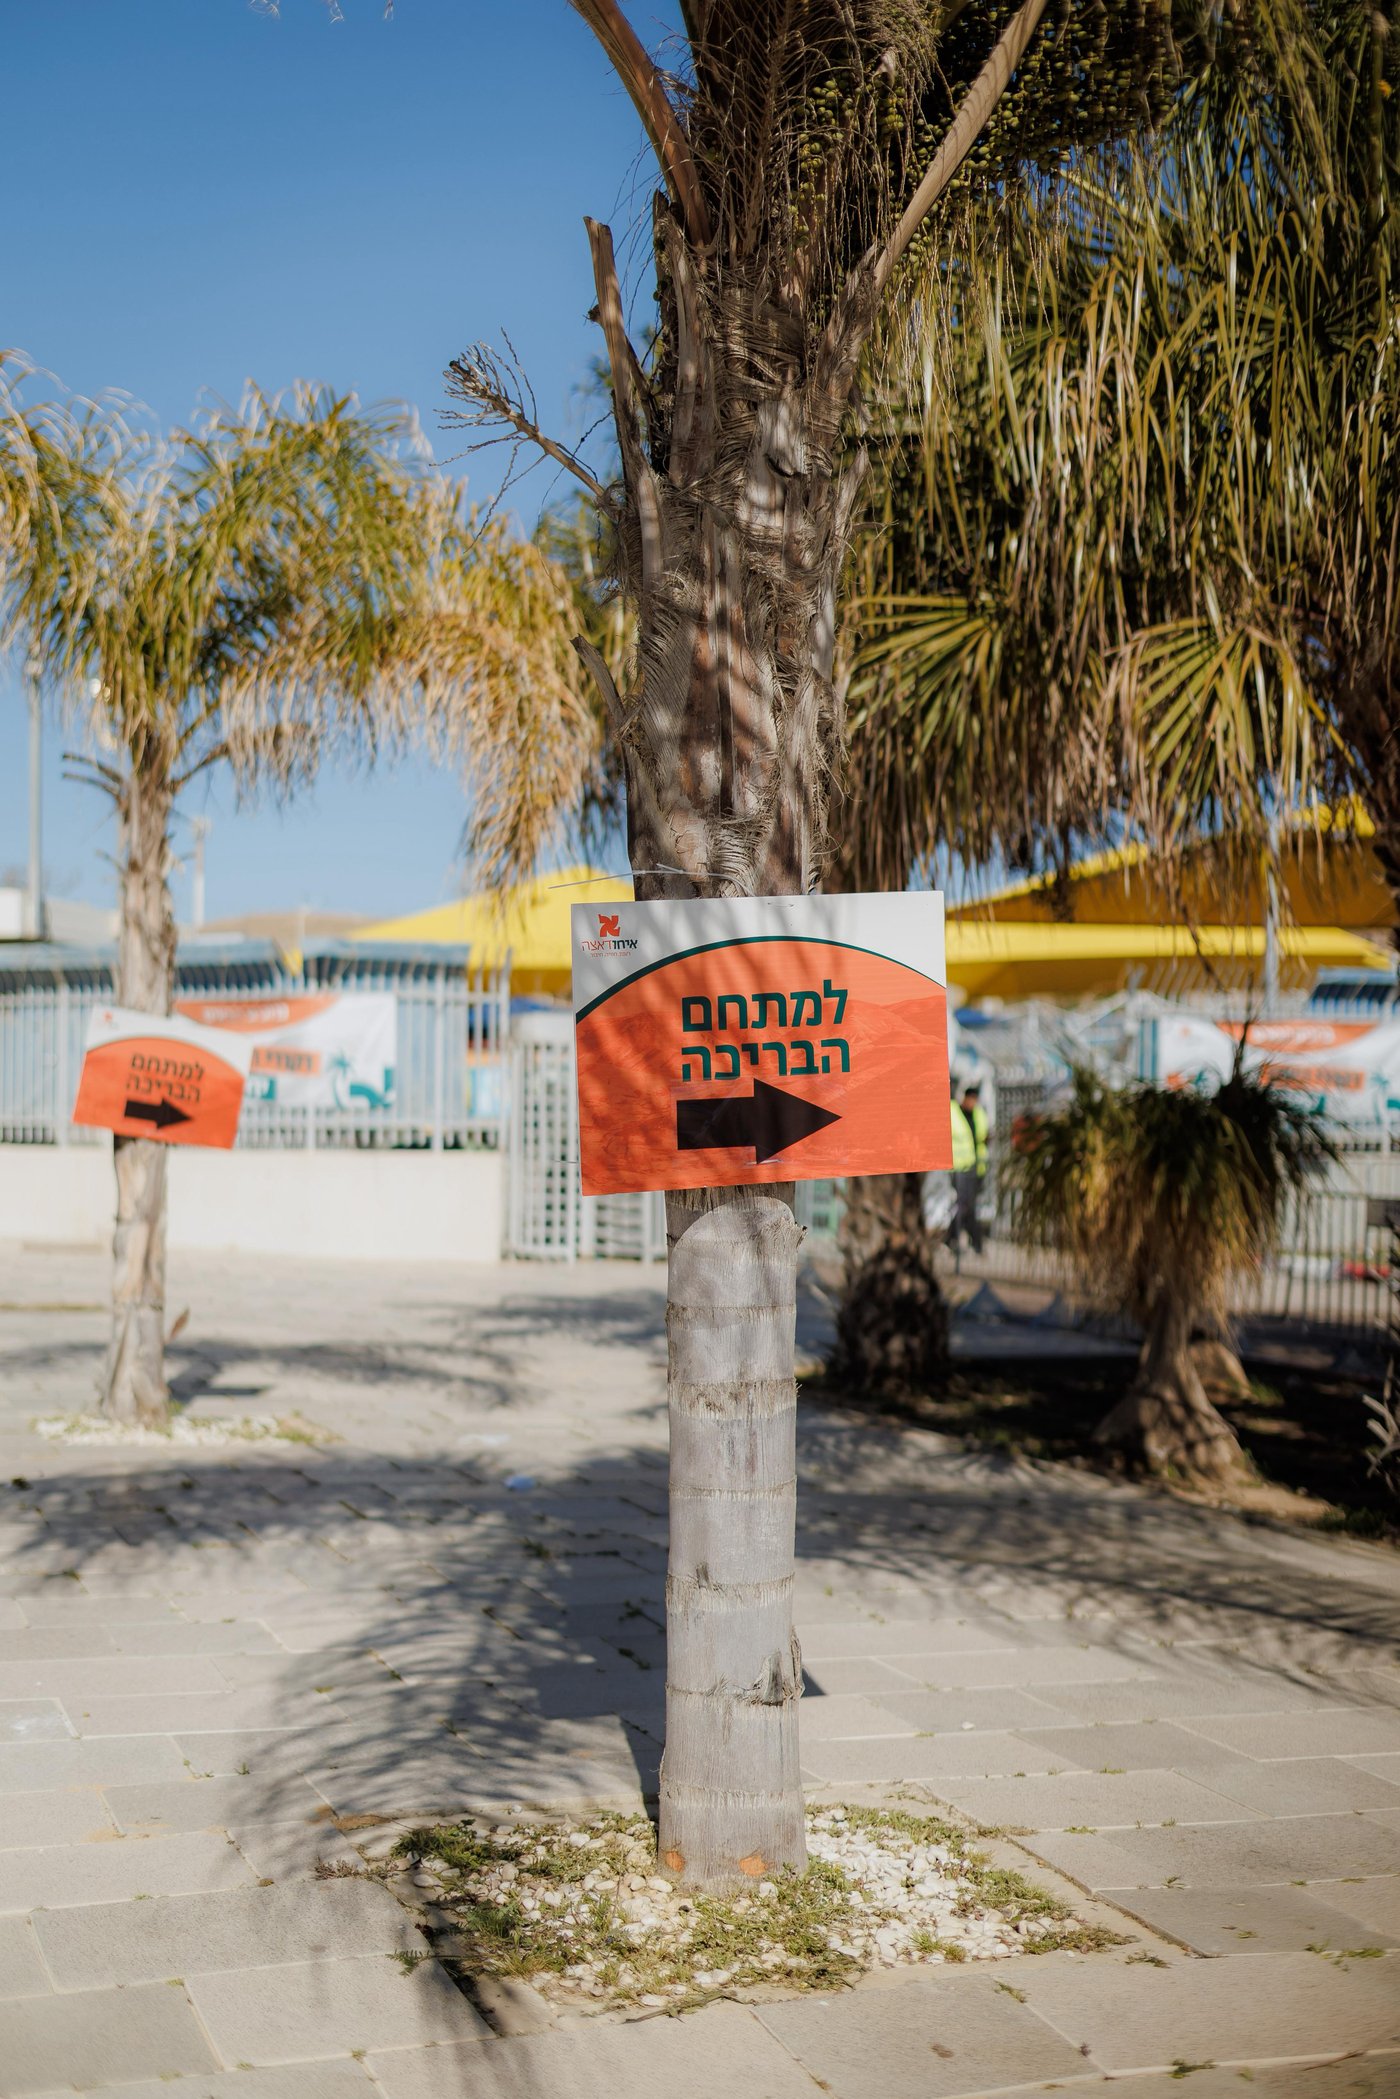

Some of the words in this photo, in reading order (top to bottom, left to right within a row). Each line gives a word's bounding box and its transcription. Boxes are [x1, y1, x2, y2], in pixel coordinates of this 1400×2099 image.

[681, 979, 848, 1033] למתחם
[130, 1051, 205, 1082] למתחם
[681, 1038, 851, 1082] הבריכה
[127, 1074, 201, 1102] הבריכה
